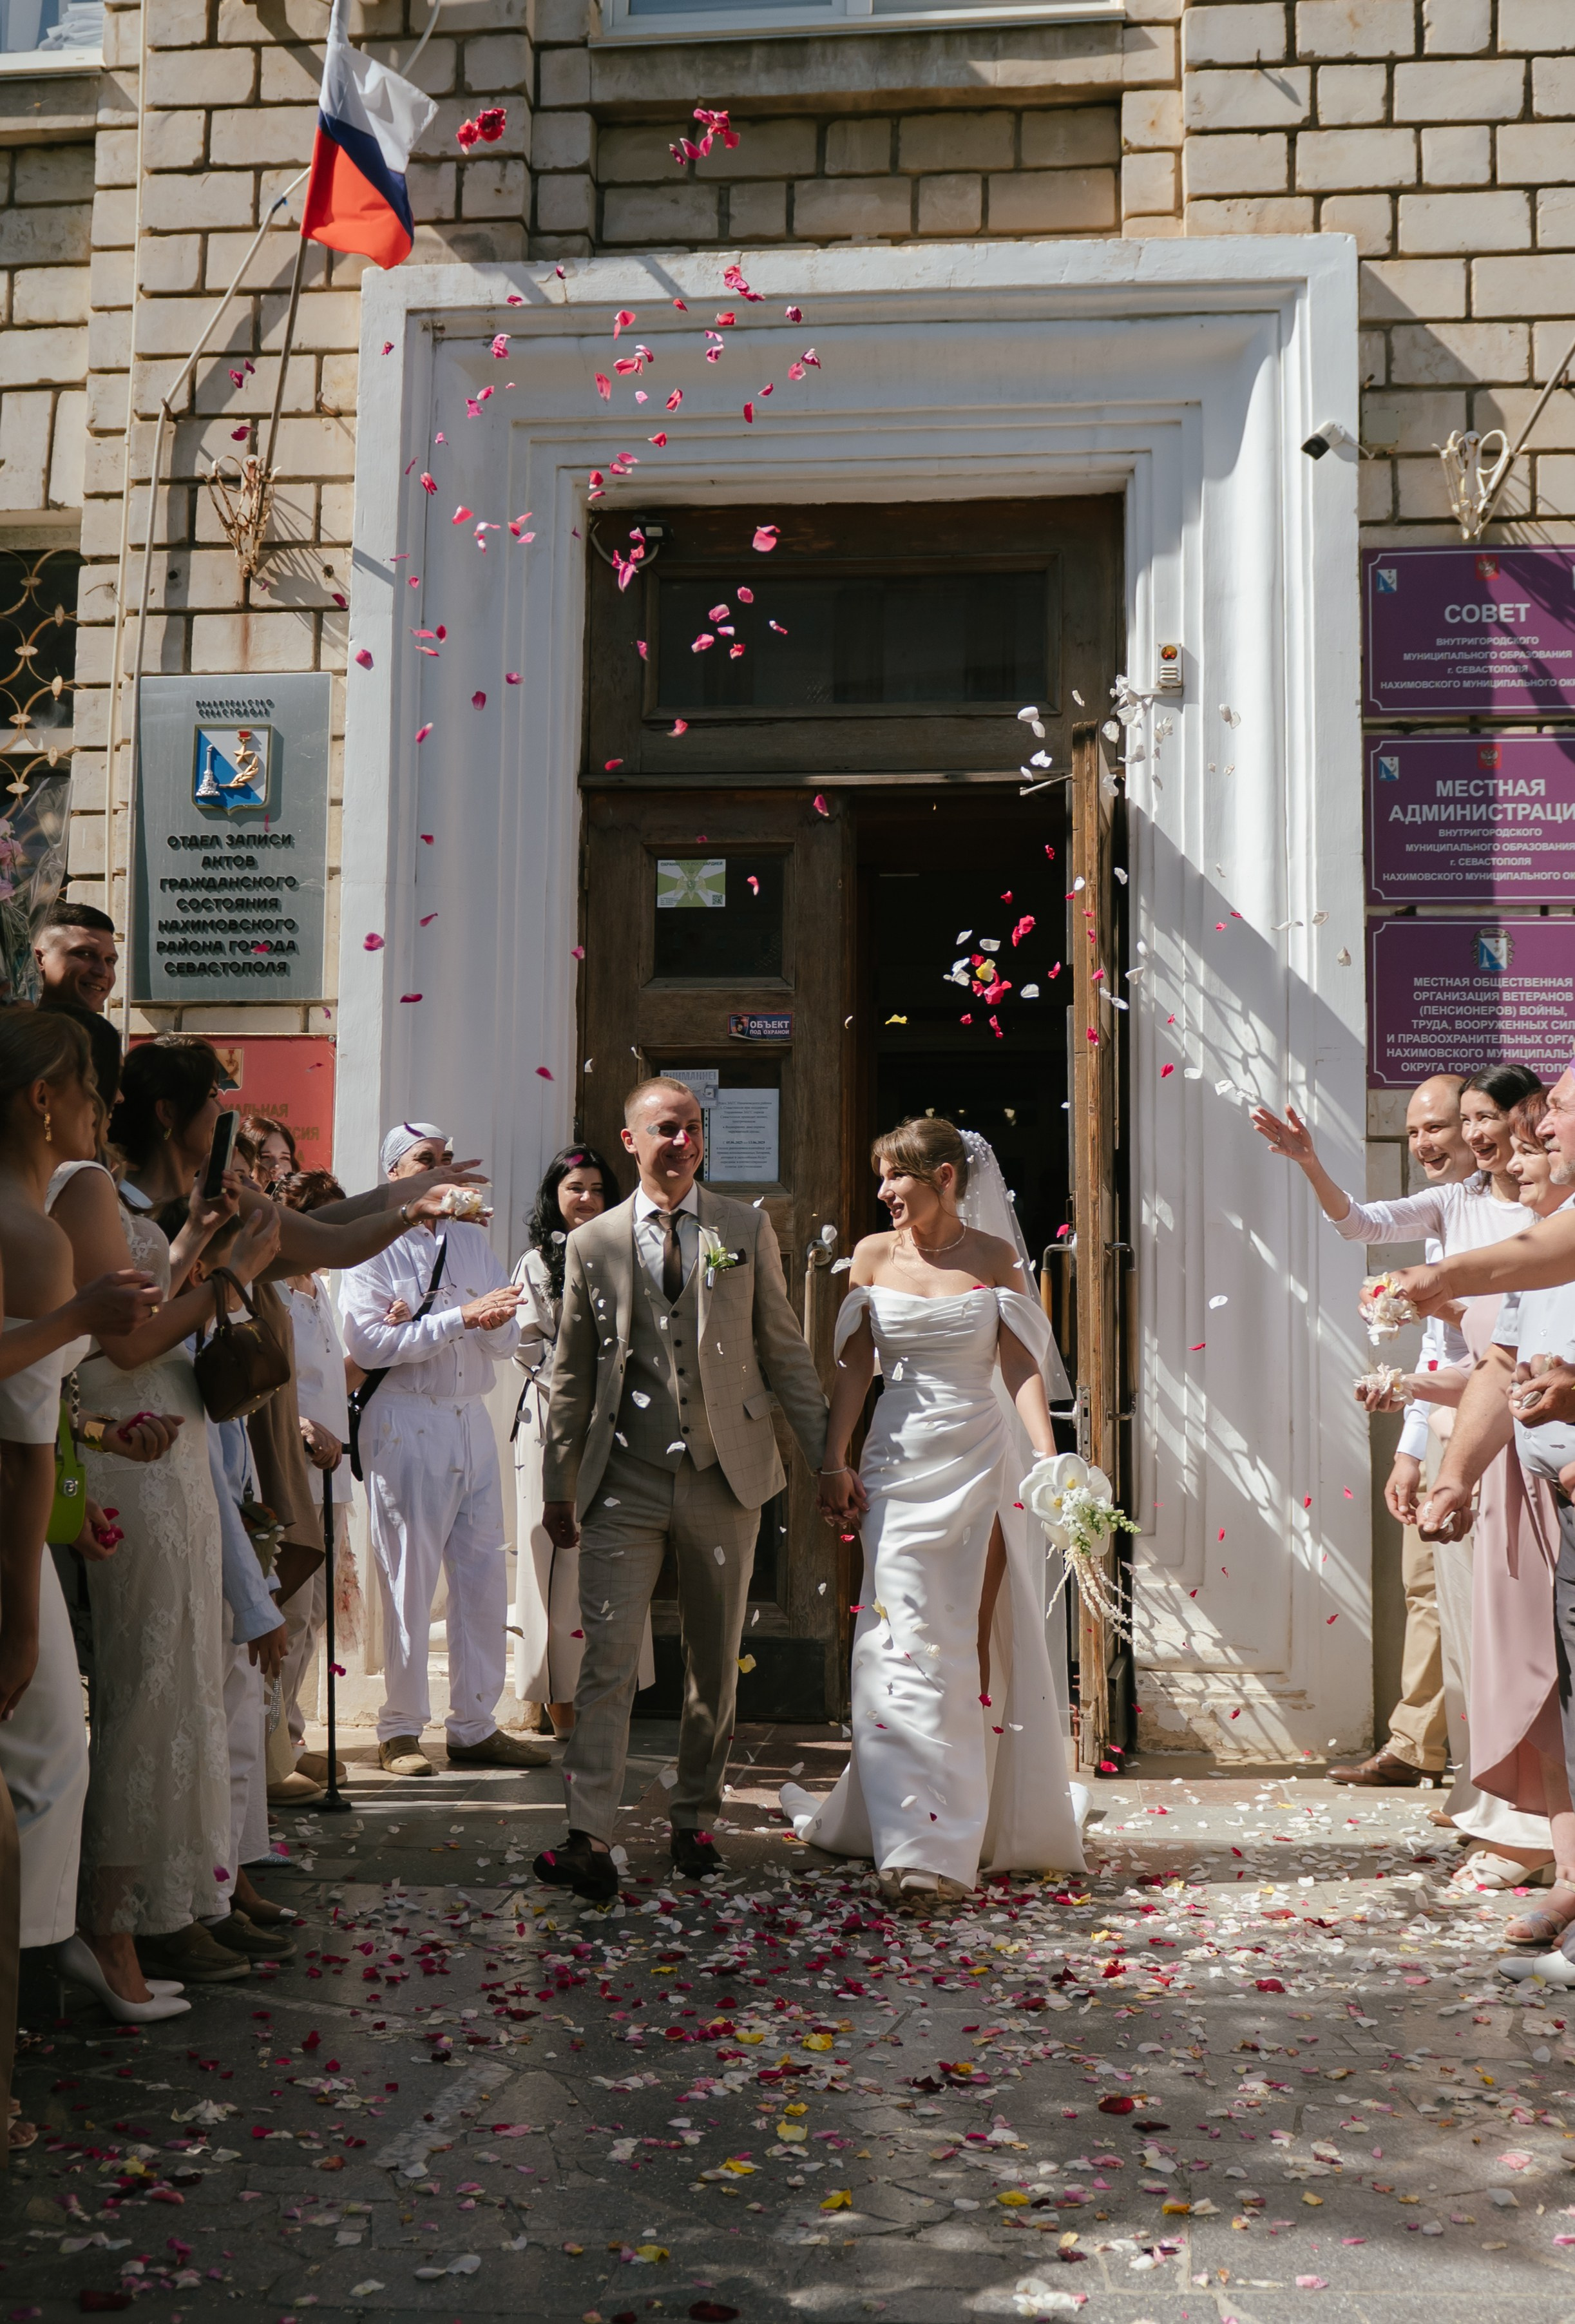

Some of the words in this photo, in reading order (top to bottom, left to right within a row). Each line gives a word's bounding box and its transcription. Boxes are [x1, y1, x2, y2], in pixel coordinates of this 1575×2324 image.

[1444, 603, 1531, 624] СОВЕТ
[1436, 636, 1540, 646] ВНУТРИГОРОДСКОГО
[1403, 651, 1498, 661] МУНИЦИПАЛЬНОГО
[1499, 649, 1572, 659] ОБРАЗОВАНИЯ
[1456, 664, 1528, 674] СЕВАСТОПОЛЯ
[1380, 680, 1460, 689] НАХИМОВСКОГО
[1462, 678, 1557, 689] МУНИЦИПАЛЬНОГО
[1436, 779, 1545, 797] МЕСТНАЯ
[1388, 803, 1575, 825] АДМИНИСТРАЦИ
[1438, 828, 1543, 838] ВНУТРИГОРОДСКОГО
[167, 834, 220, 848] ОТДЕЛ
[225, 834, 293, 846] ЗАПИСИ
[1406, 843, 1500, 852] МУНИЦИПАЛЬНОГО
[1502, 842, 1575, 851] ОБРАЗОВАНИЯ
[202, 855, 256, 868] АКТОВ
[1458, 857, 1532, 866] СЕВАСТОПОЛЯ
[1382, 872, 1463, 881] НАХИМОВСКОГО
[1465, 871, 1561, 882] МУНИЦИПАЛЬНОГО
[160, 876, 297, 890] ГРАЖДАНСКОГО
[177, 898, 278, 910] СОСТОЯНИЯ
[158, 918, 296, 932] НАХИМОВСКОГО
[157, 937, 224, 952] РАЙОНА
[164, 961, 287, 974] СЕВАСТОПОЛЯ
[1413, 977, 1470, 986] МЕСТНАЯ
[1473, 977, 1573, 988] ОБЩЕСТВЕННАЯ
[1413, 992, 1500, 1002] ОРГАНИЗАЦИЯ
[1502, 992, 1574, 1001] ВЕТЕРАНОВ
[1419, 1006, 1516, 1017] (ПЕНСИОНЕРОВ)
[1519, 1004, 1567, 1017] ВОЙНЫ,
[1411, 1020, 1452, 1031] ТРУДА,
[1455, 1020, 1549, 1030] ВООРУЖЕННЫХ
[1550, 1020, 1575, 1030] СИЛ
[1386, 1034, 1395, 1043] И
[1398, 1034, 1543, 1044] ПРАВООХРАНИТЕЛЬНЫХ
[1386, 1048, 1484, 1058] НАХИМОВСКОГО
[1400, 1062, 1445, 1072] ОКРУГА
